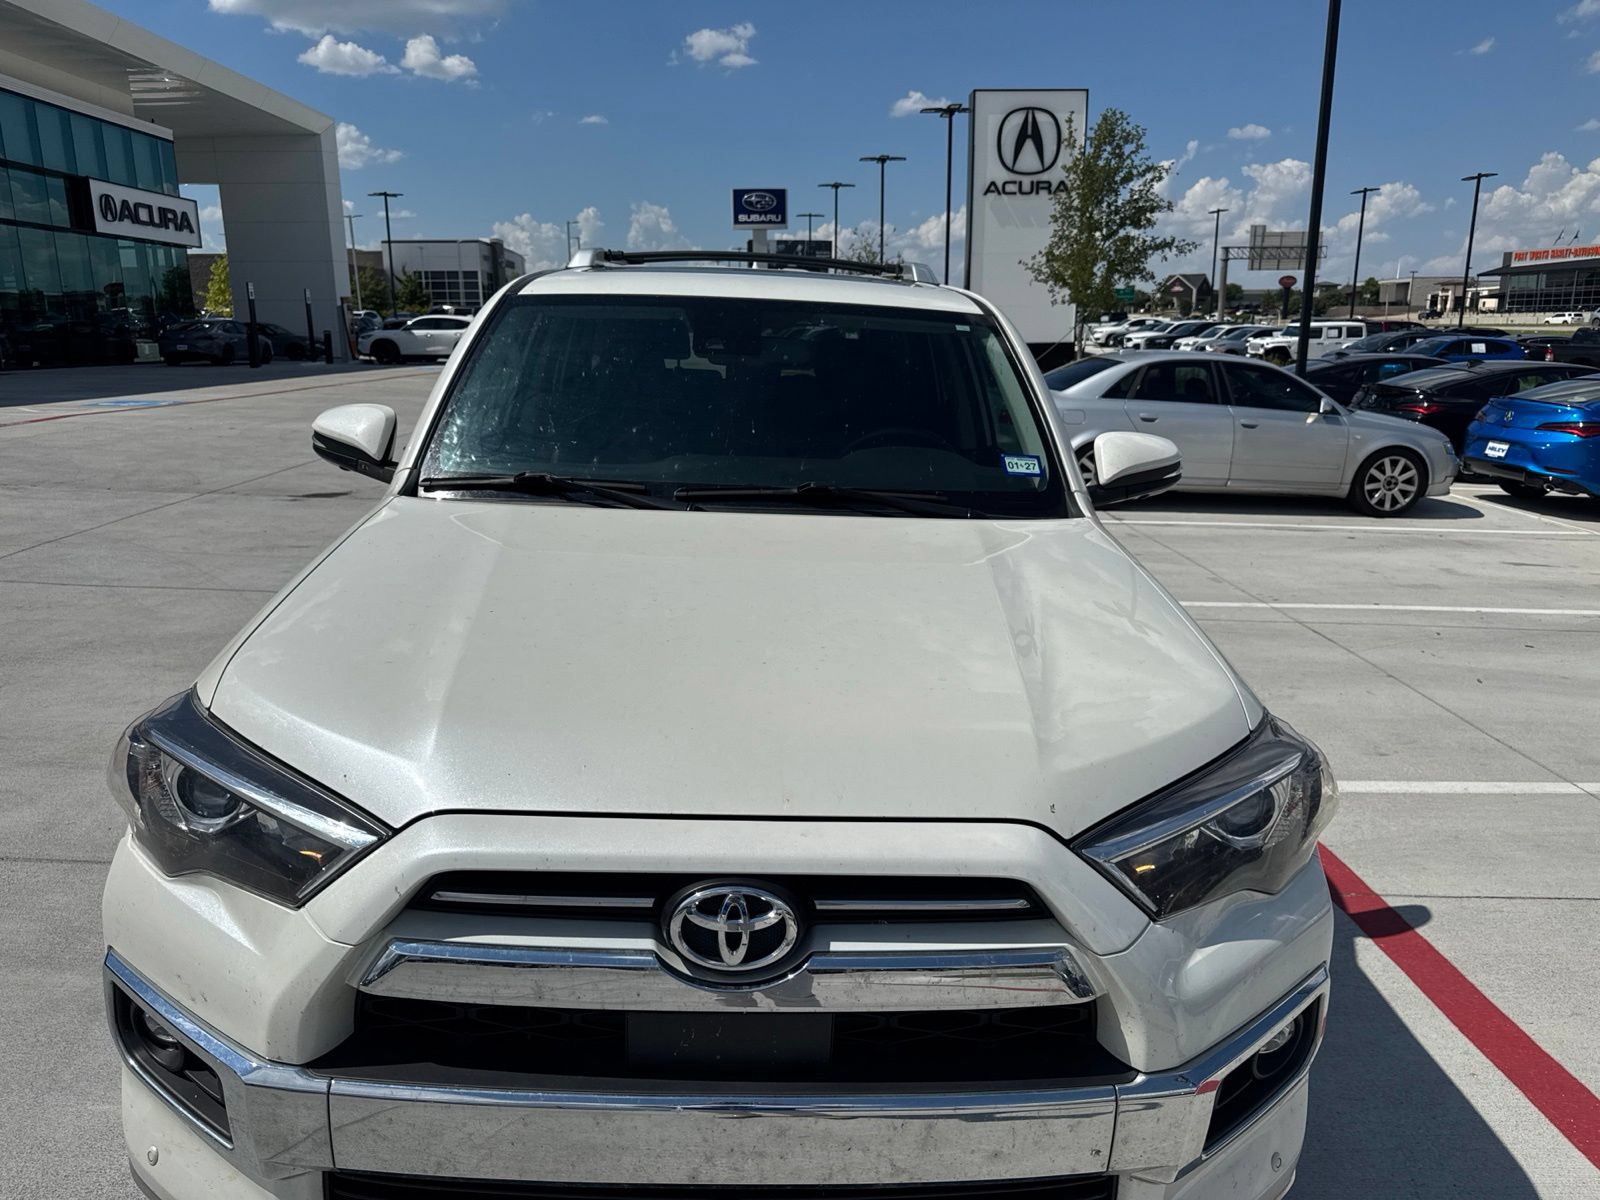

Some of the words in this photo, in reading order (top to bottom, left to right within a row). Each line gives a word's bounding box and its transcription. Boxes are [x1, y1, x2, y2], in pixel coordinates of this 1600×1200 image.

[983, 181, 1070, 197] ACURA
[118, 199, 196, 234] ACURA
[738, 214, 782, 222] SUBARU
